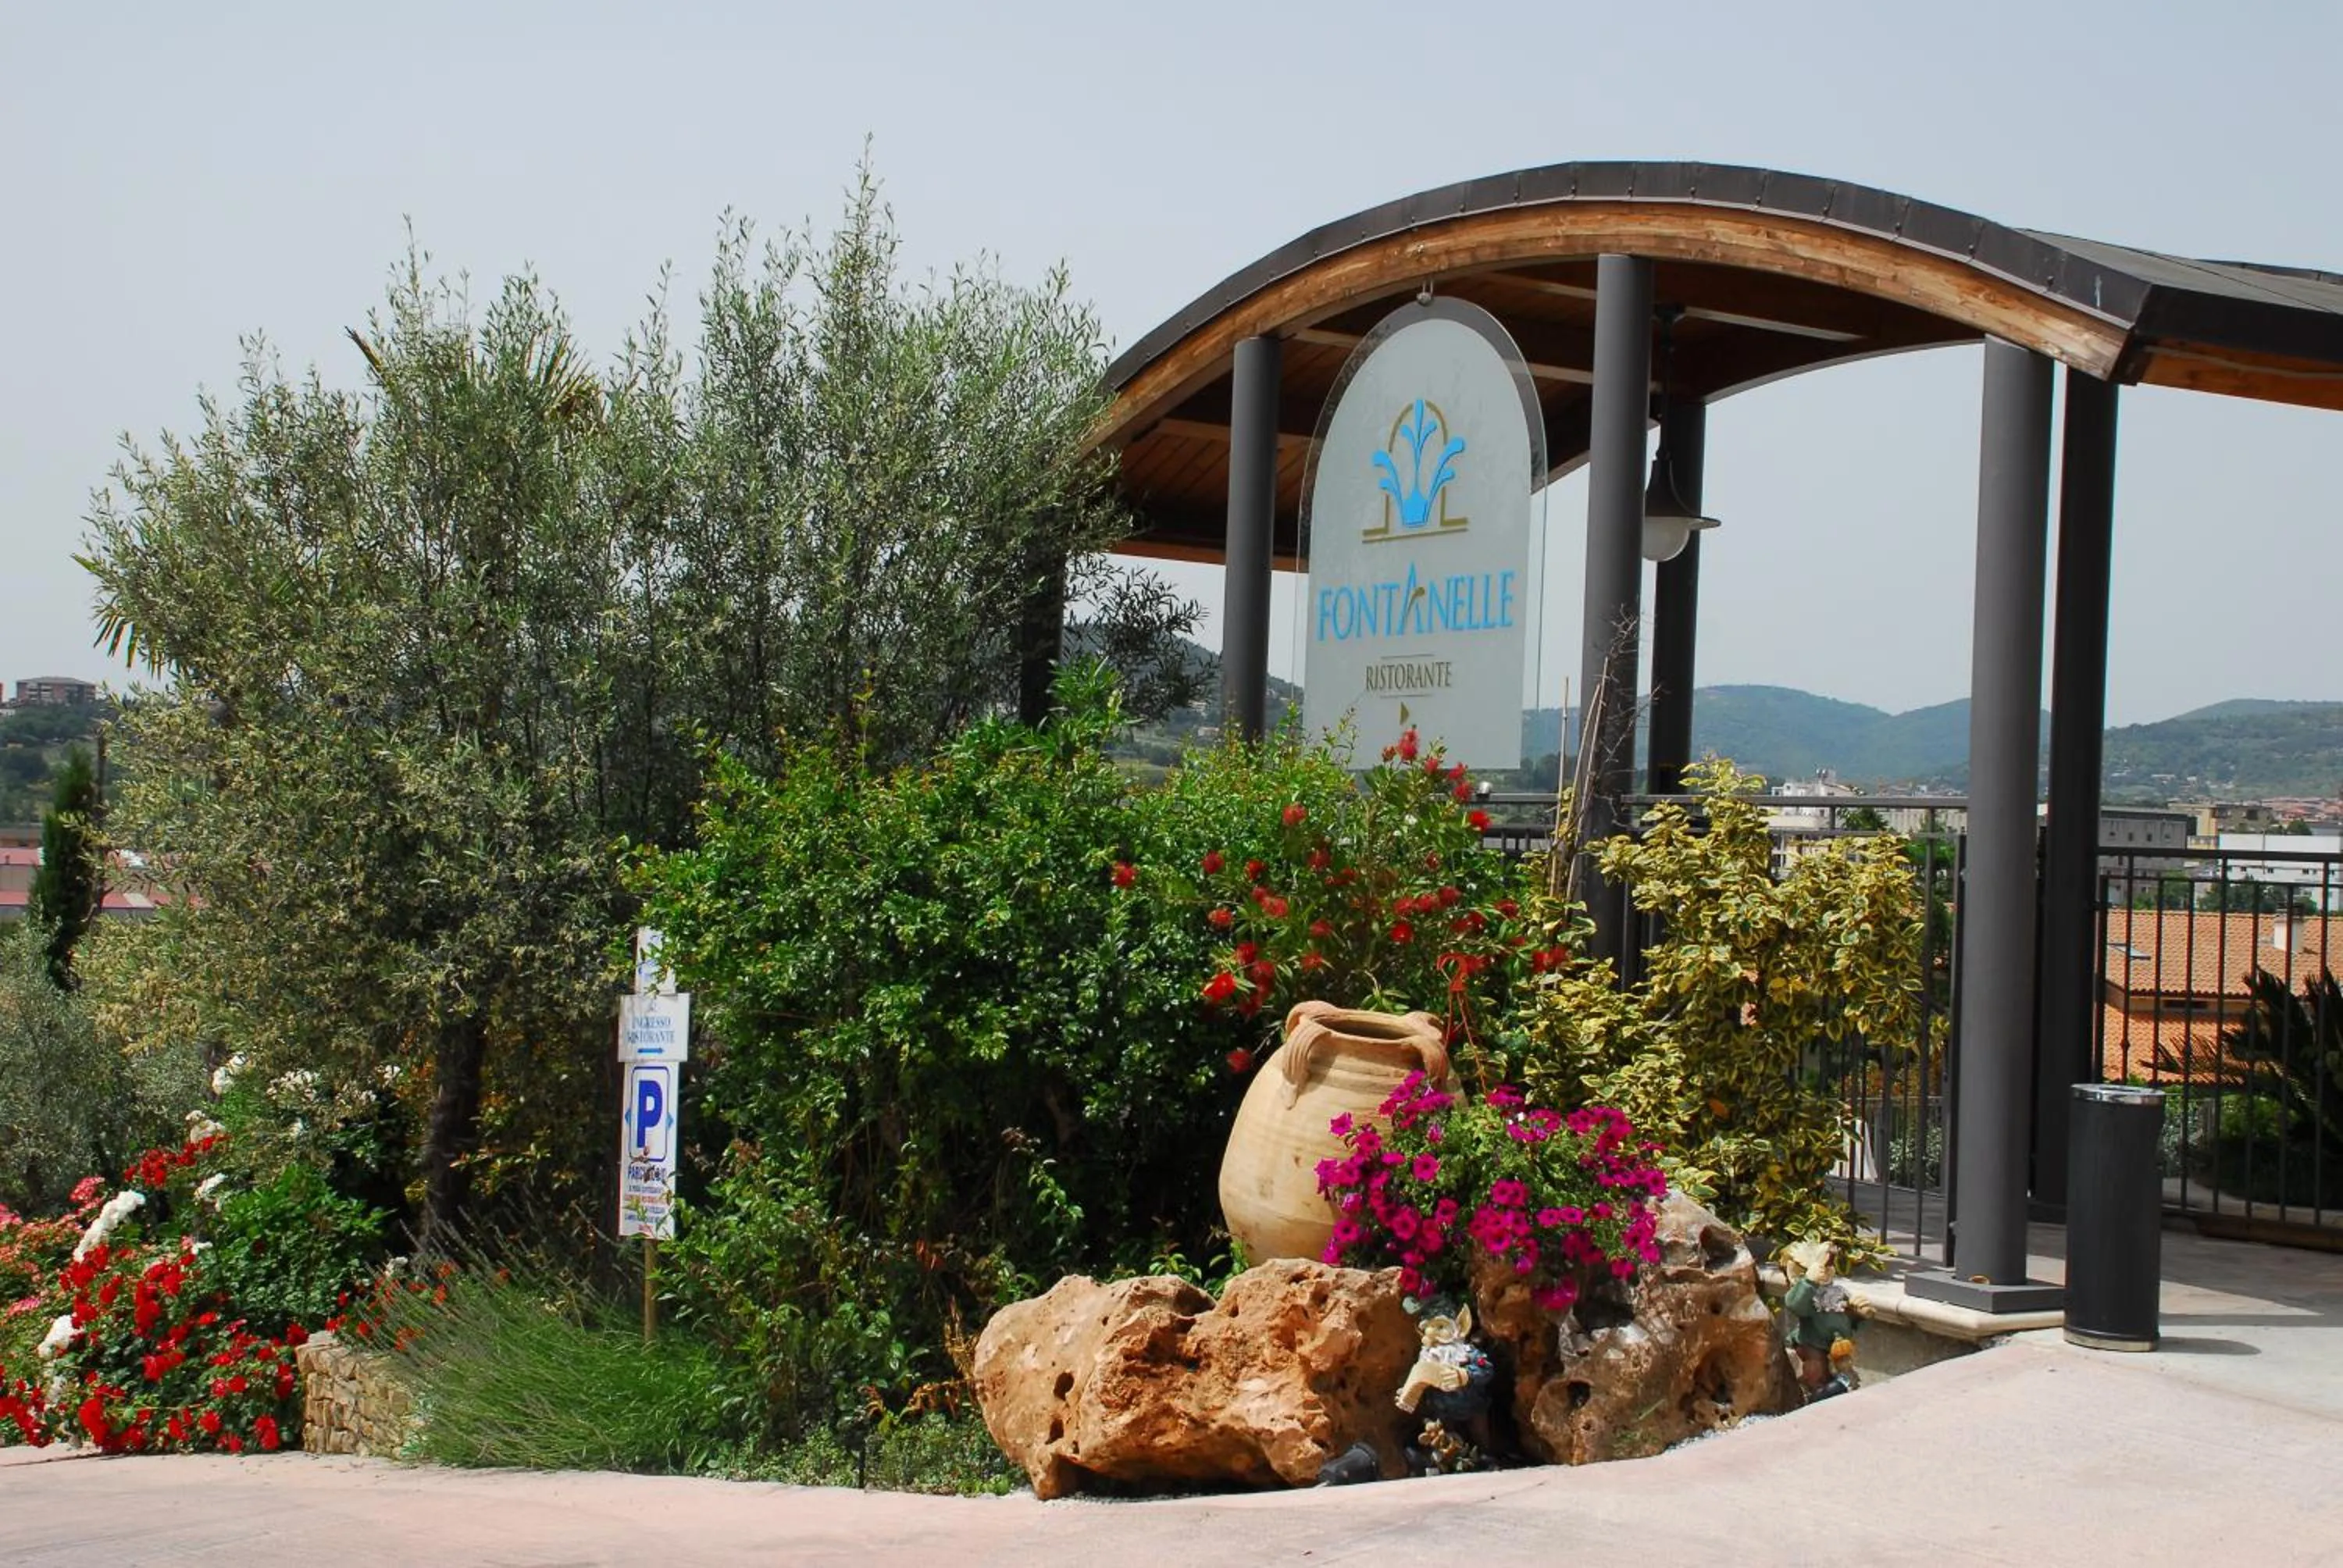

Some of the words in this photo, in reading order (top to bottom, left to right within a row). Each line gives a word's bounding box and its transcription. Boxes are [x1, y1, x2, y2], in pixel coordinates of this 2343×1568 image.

[1317, 561, 1515, 641] FONTANELLE
[1366, 661, 1452, 690] RISTORANTE
[637, 1080, 662, 1149] P
